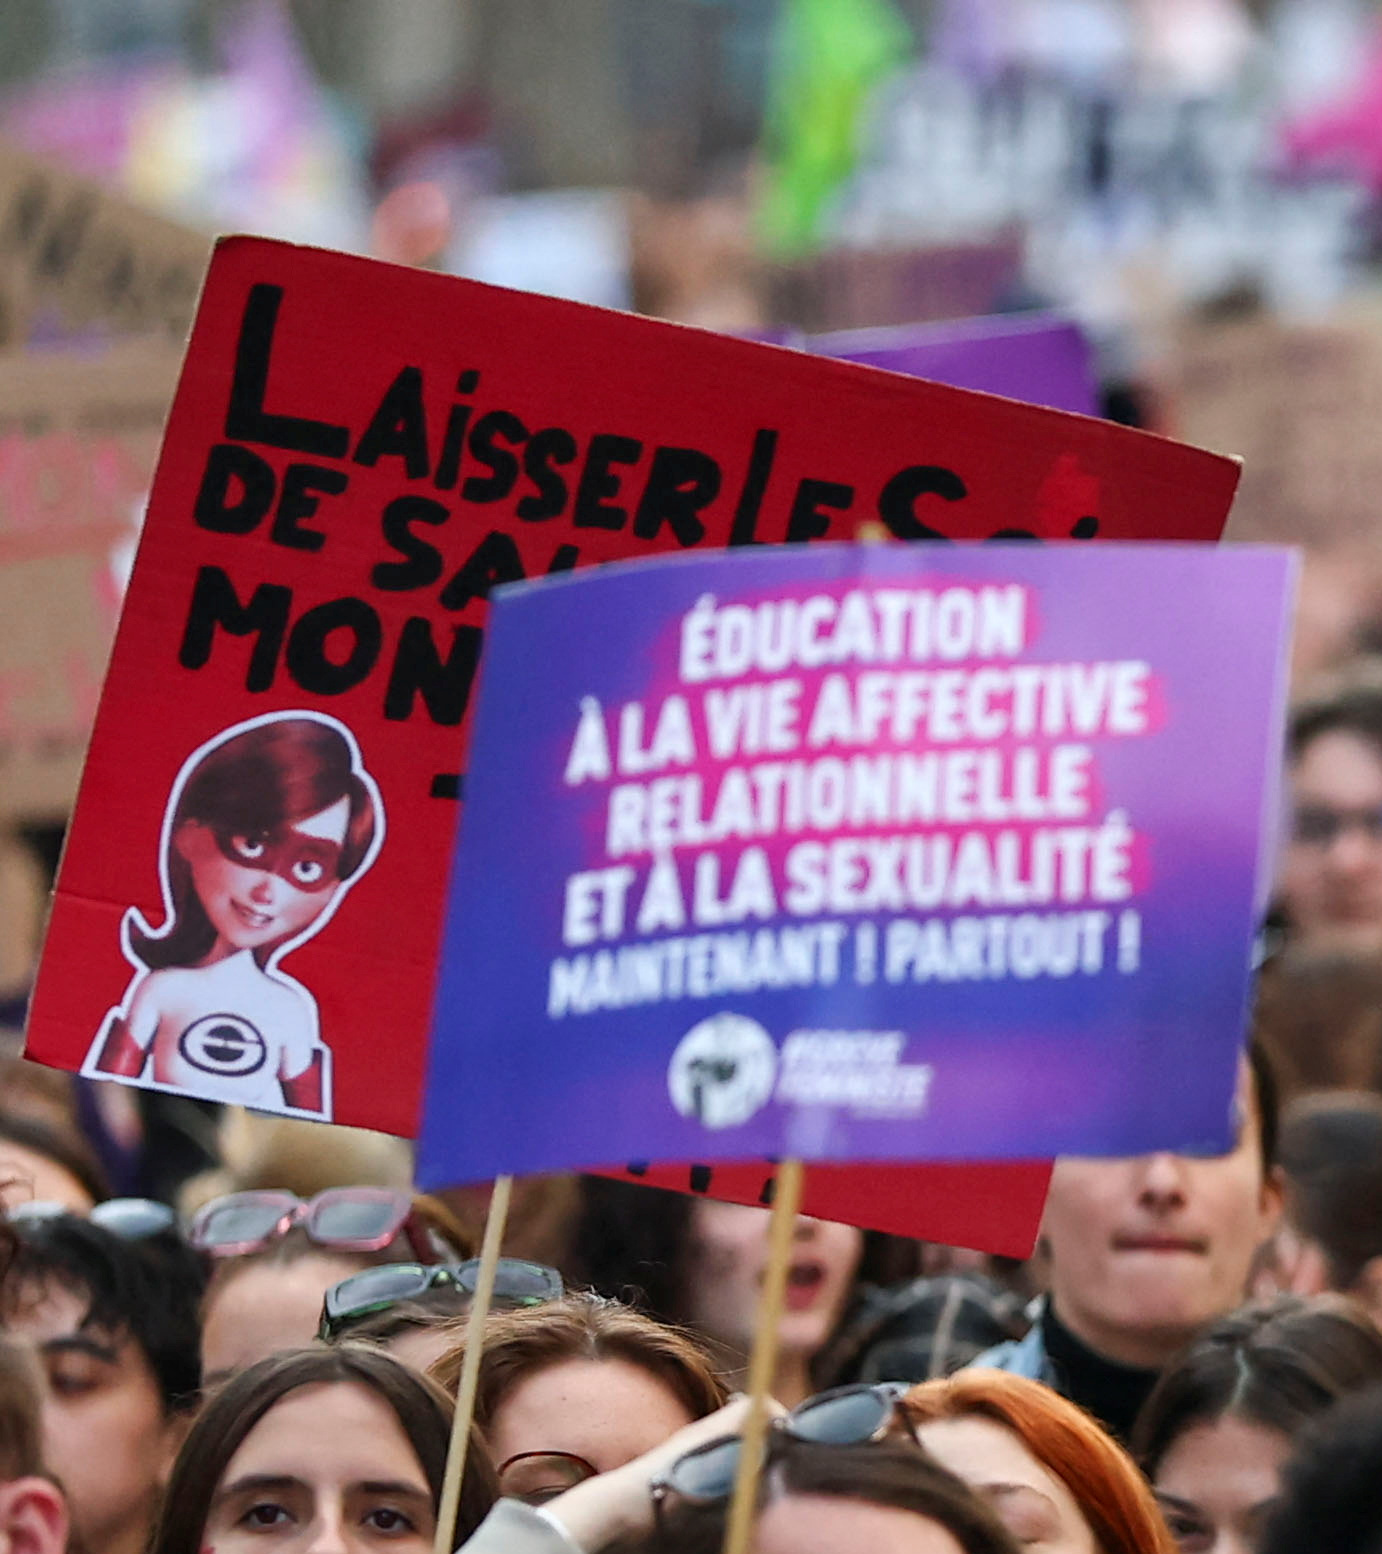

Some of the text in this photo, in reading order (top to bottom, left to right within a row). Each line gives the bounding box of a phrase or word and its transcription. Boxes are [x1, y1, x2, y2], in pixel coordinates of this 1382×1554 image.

[194, 443, 349, 552] DE
[679, 584, 1024, 683] ÉDUCATION
[564, 660, 1150, 786] À LA VIE AFFECTIVE
[605, 744, 1092, 858] RELATIONNELLE
[563, 812, 1132, 946] ET À LA SEXUALITÉ
[547, 907, 1141, 1018] MAINTENANT ! PARTOUT !
